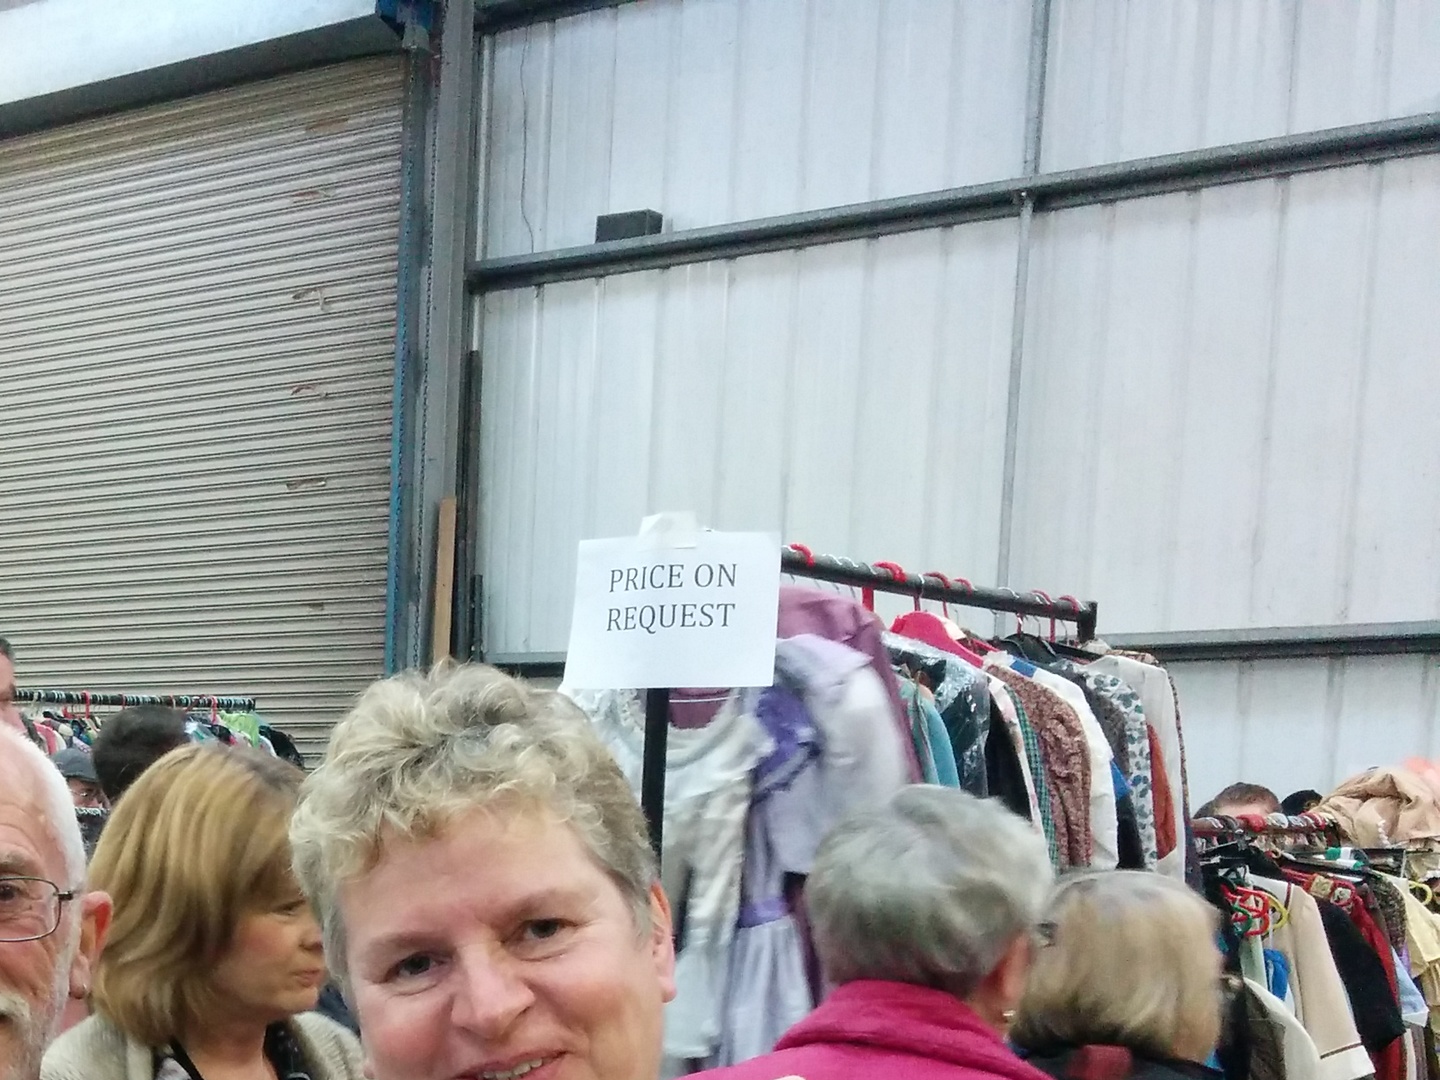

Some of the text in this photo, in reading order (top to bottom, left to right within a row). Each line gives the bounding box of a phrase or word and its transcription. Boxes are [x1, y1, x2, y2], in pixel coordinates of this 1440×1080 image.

[609, 563, 737, 593] PRICE ON
[606, 603, 736, 634] REQUEST
